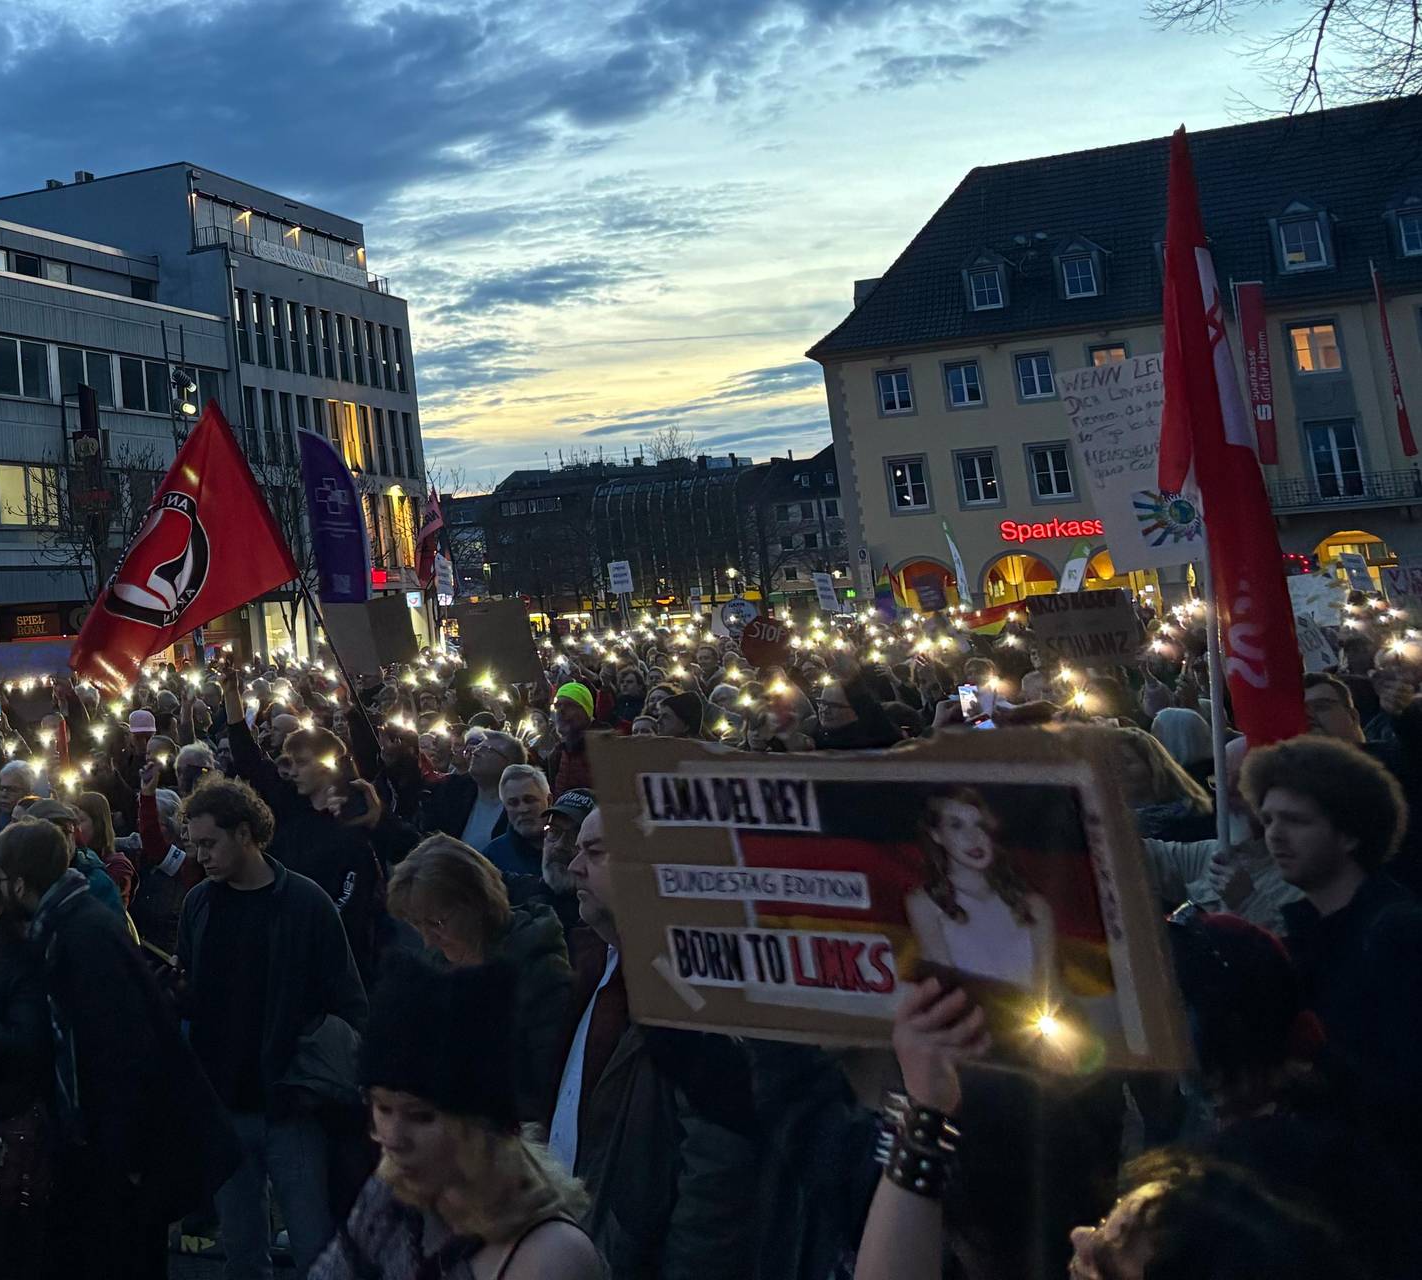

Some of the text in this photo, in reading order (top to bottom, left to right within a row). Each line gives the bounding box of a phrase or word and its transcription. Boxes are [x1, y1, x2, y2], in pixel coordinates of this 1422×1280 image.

[1061, 365, 1122, 392] WENN
[1000, 518, 1105, 543] Sparkass
[16, 614, 46, 626] SPIEL
[18, 625, 49, 635] ROYAL
[748, 621, 788, 643] STOP
[643, 776, 811, 826] LANA DEL REY
[661, 868, 864, 898] BUNDESTAG EDITION
[672, 928, 897, 994] BORN TO LINKS
